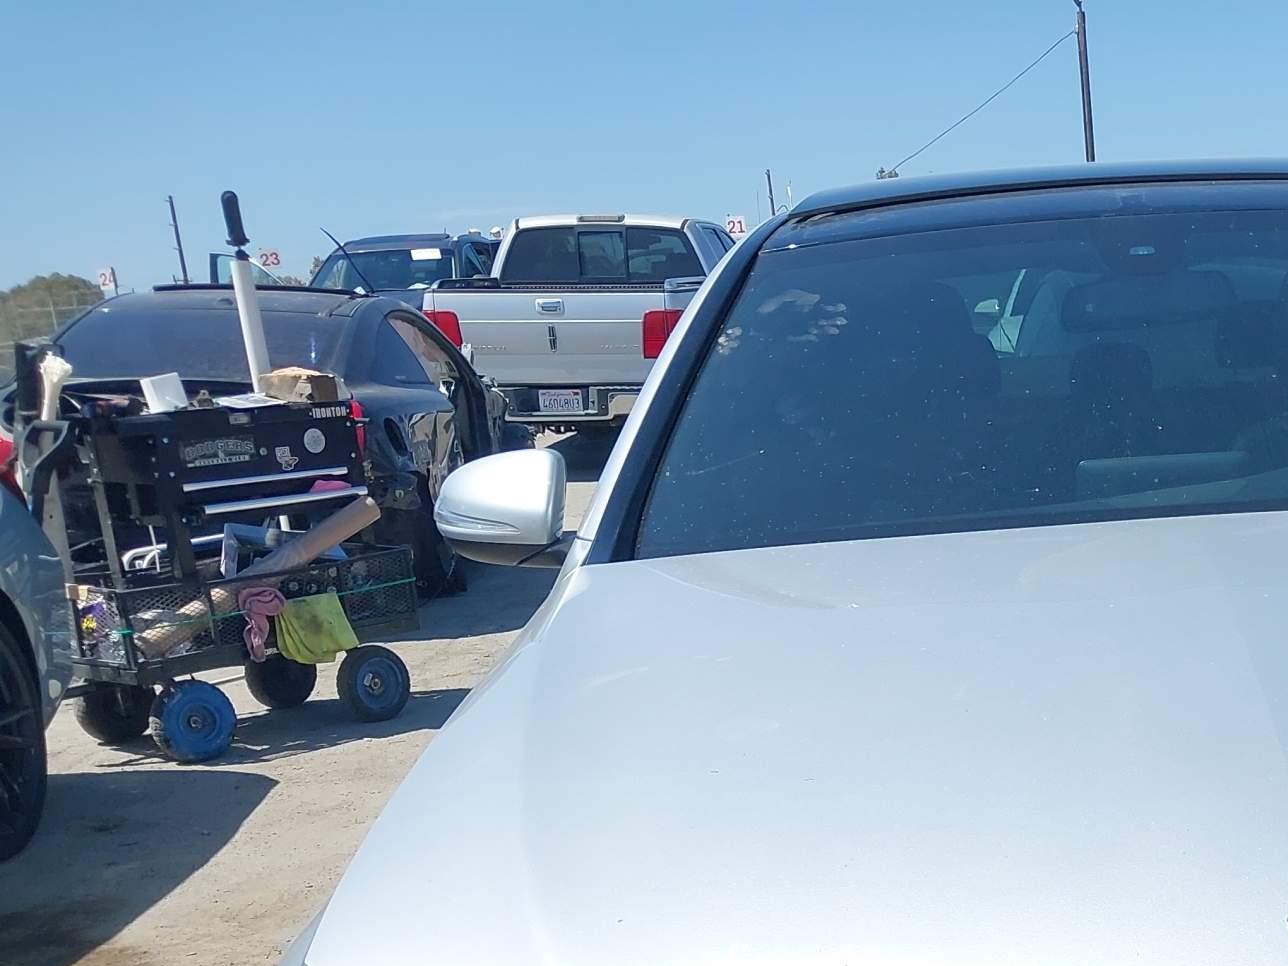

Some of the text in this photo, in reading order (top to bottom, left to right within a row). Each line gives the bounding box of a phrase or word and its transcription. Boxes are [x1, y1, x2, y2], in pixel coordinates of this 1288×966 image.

[727, 219, 745, 234] 21
[260, 252, 280, 266] 23
[185, 439, 255, 462] DODGERS
